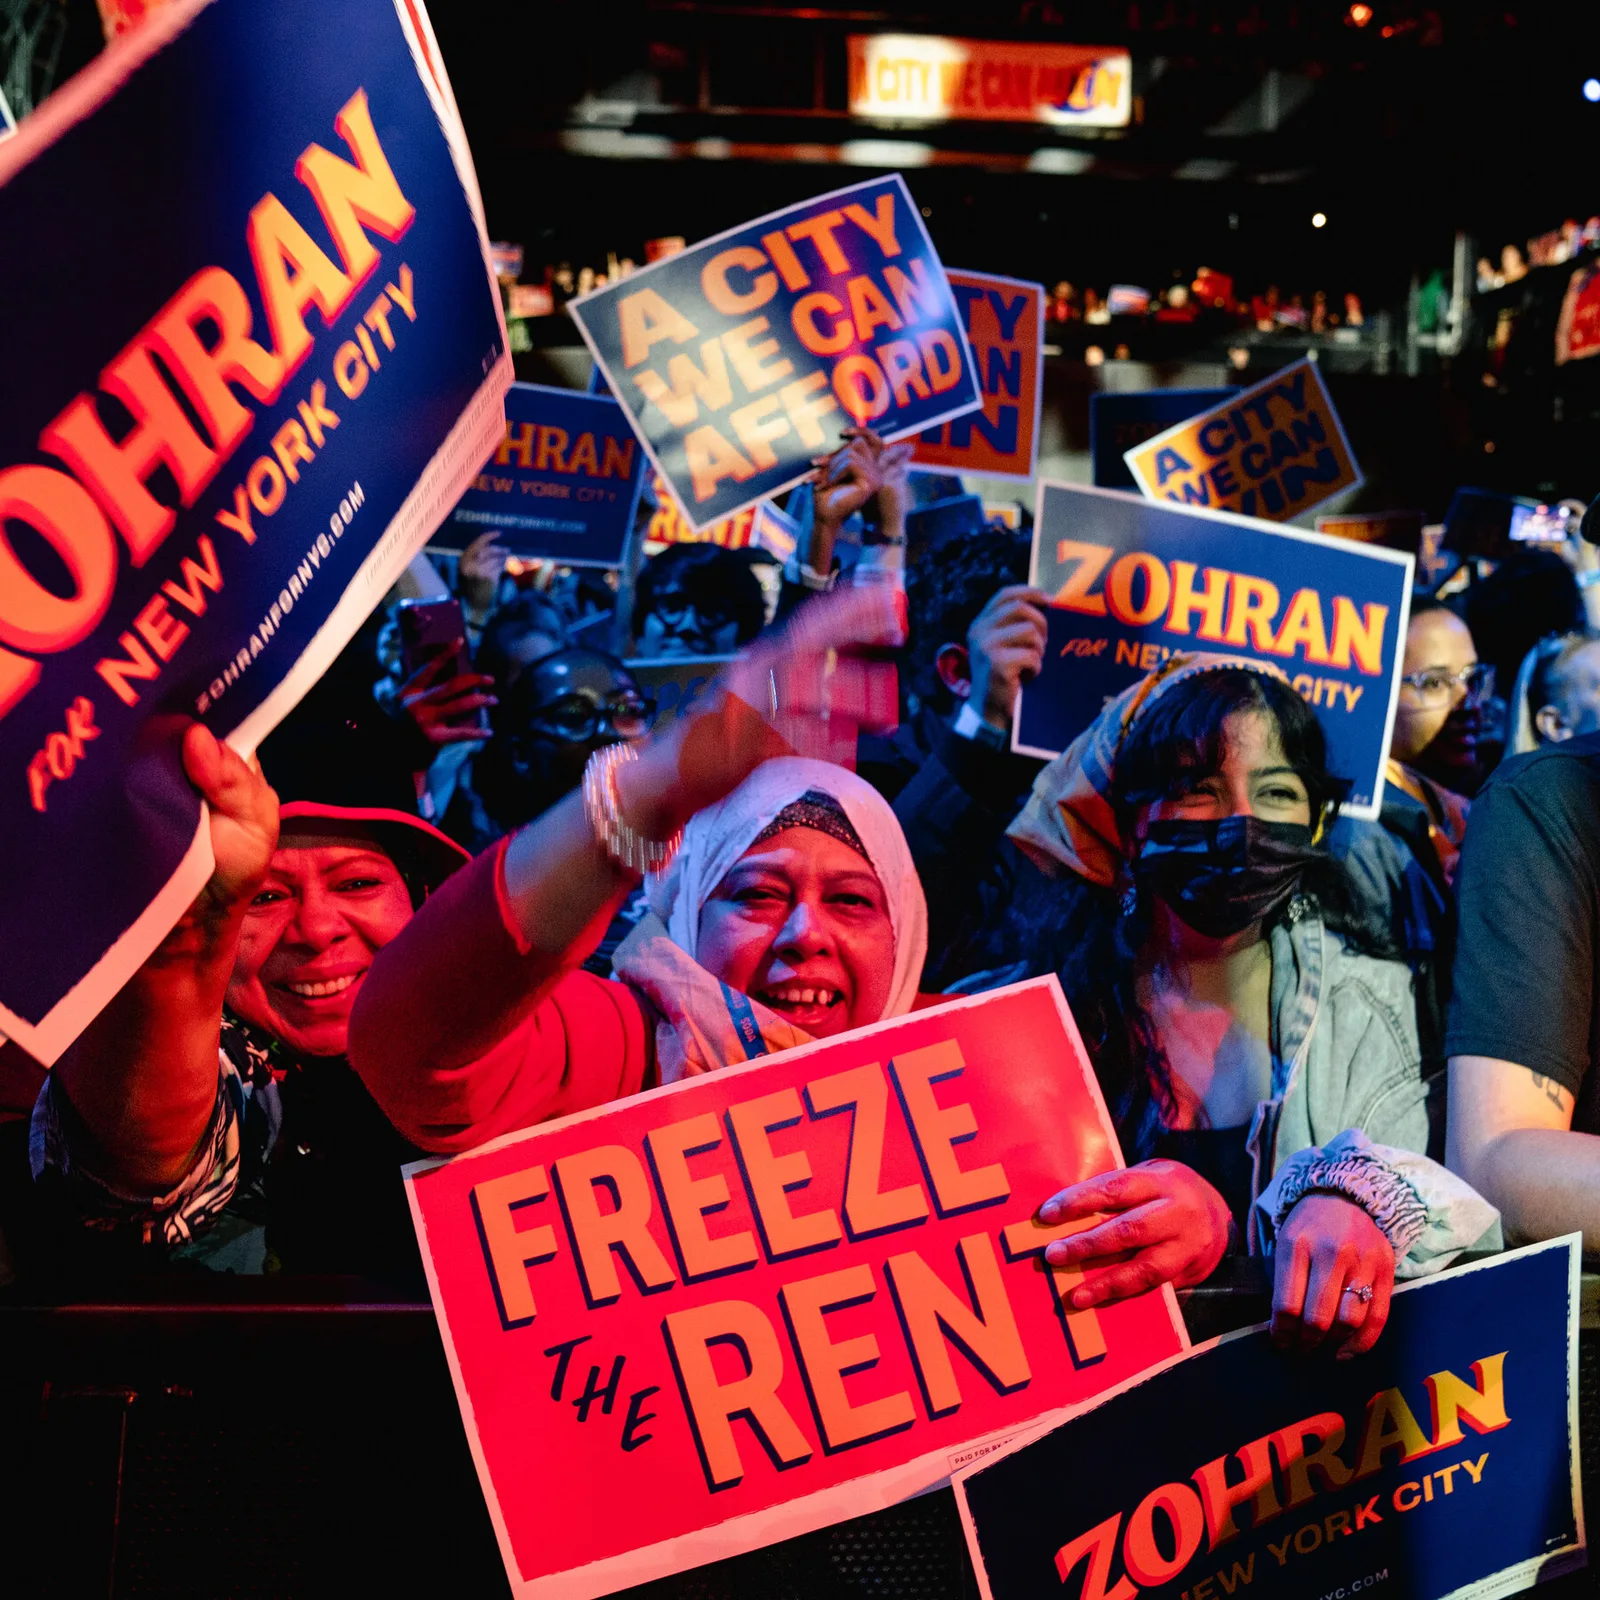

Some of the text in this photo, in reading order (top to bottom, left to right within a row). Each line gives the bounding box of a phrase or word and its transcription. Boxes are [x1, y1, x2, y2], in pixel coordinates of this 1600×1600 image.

[619, 194, 902, 368] A CITY
[633, 258, 946, 428] WE CAN
[493, 418, 636, 481] HRAN
[1154, 373, 1306, 487] A CITY
[1166, 410, 1326, 506] WE CAN
[1219, 447, 1341, 517] IN
[26, 262, 417, 813] FOR NEW YORK CITY
[1047, 539, 1389, 676] ZOHRAN
[1060, 637, 1108, 658] FOR
[1292, 672, 1364, 713] CITY
[469, 1037, 1011, 1331] FREEZE
[543, 1334, 661, 1452] THE
[660, 1210, 1108, 1495] RENT
[954, 1453, 973, 1465] PAID
[974, 1446, 991, 1458] FOR
[1053, 1349, 1512, 1600] ZOHRAN
[1181, 1451, 1491, 1600] EW YORK CITY
